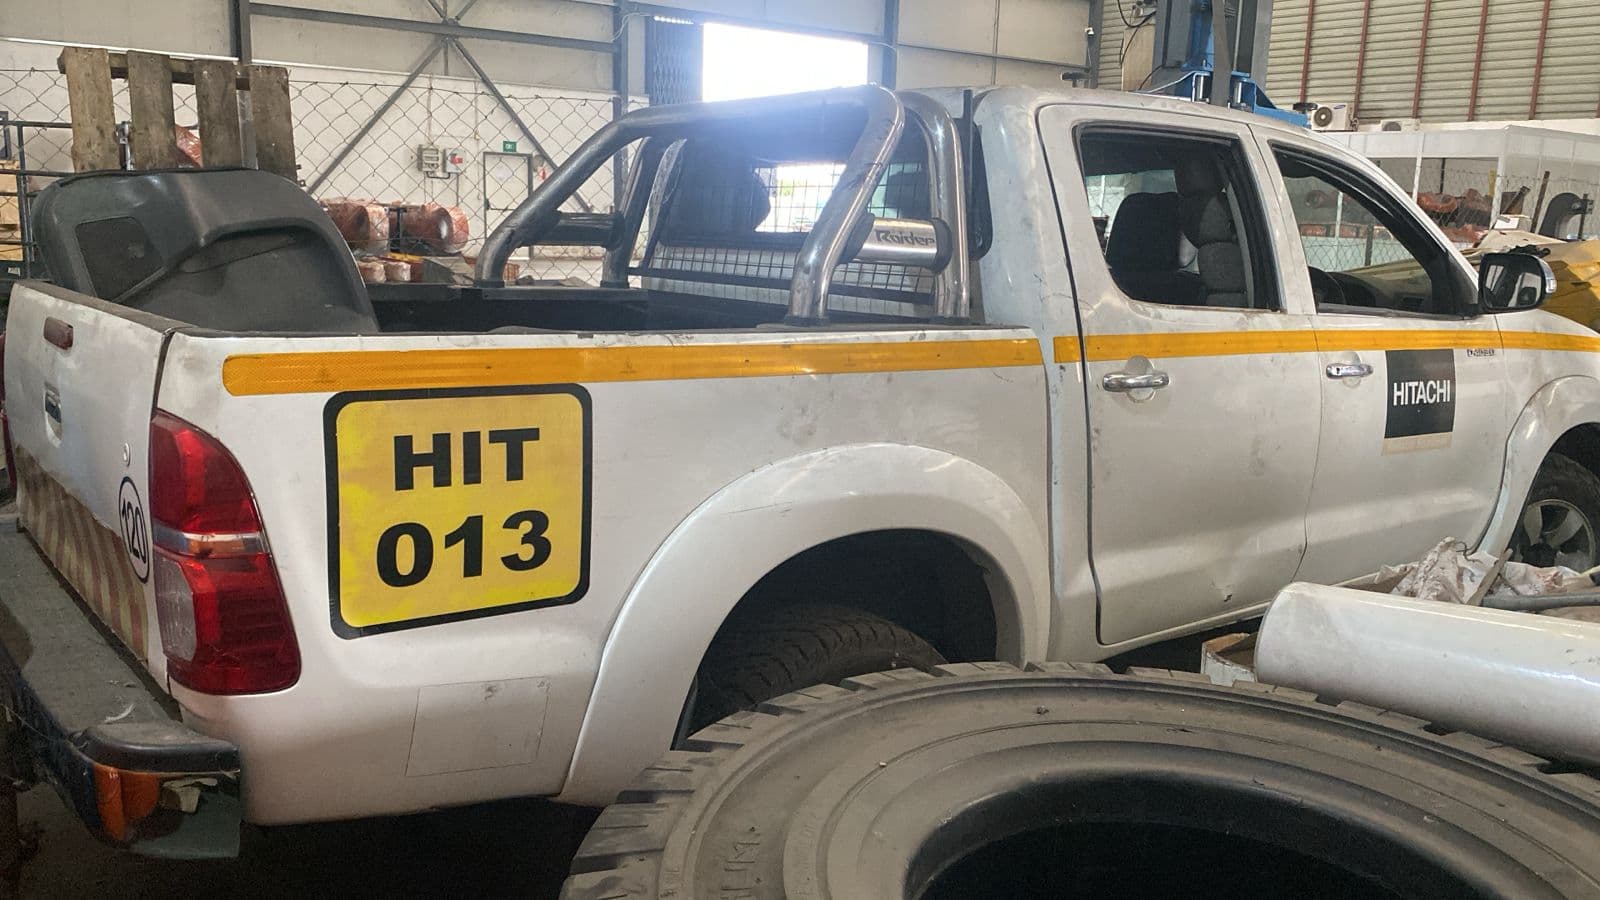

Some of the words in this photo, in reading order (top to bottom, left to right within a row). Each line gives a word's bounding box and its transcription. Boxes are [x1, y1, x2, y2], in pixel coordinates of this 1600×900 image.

[875, 229, 935, 246] Raider
[1393, 380, 1451, 406] HITACHI
[394, 428, 540, 491] HIT
[121, 497, 147, 565] 120
[376, 509, 552, 588] 013
